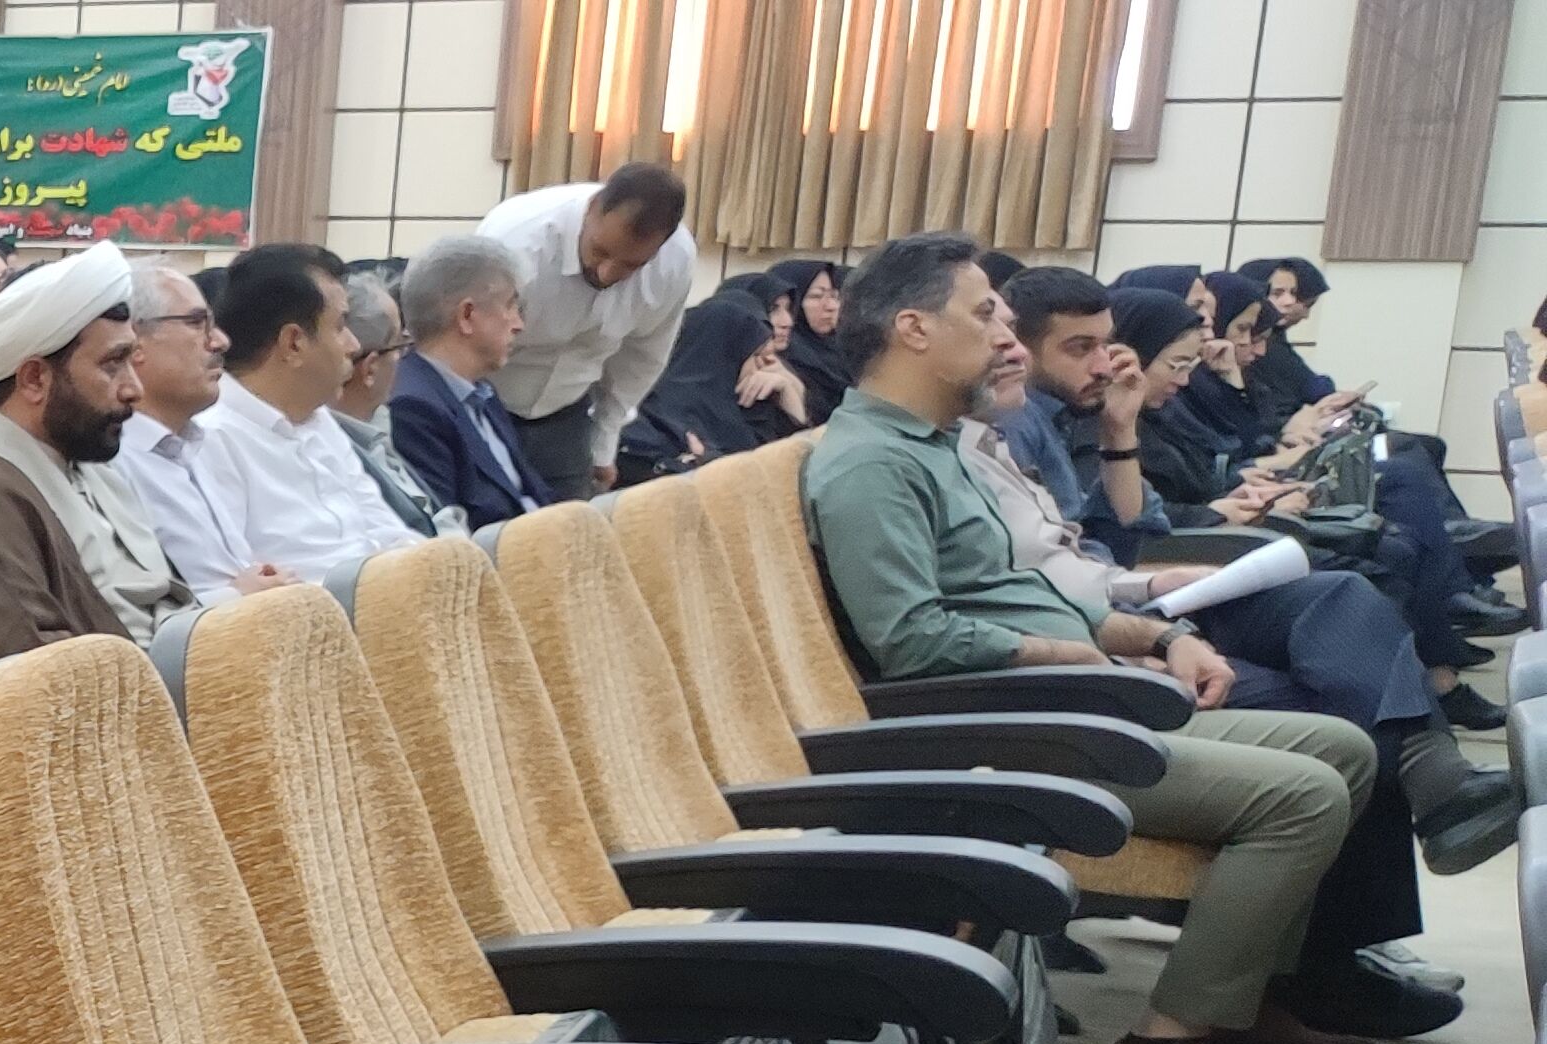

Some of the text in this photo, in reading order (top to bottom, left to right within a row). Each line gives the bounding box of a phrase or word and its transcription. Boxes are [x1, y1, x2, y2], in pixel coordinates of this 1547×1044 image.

[96, 71, 131, 107] امام
[39, 126, 129, 158] شهادت
[134, 124, 171, 153] که
[175, 124, 243, 160] ملتی
